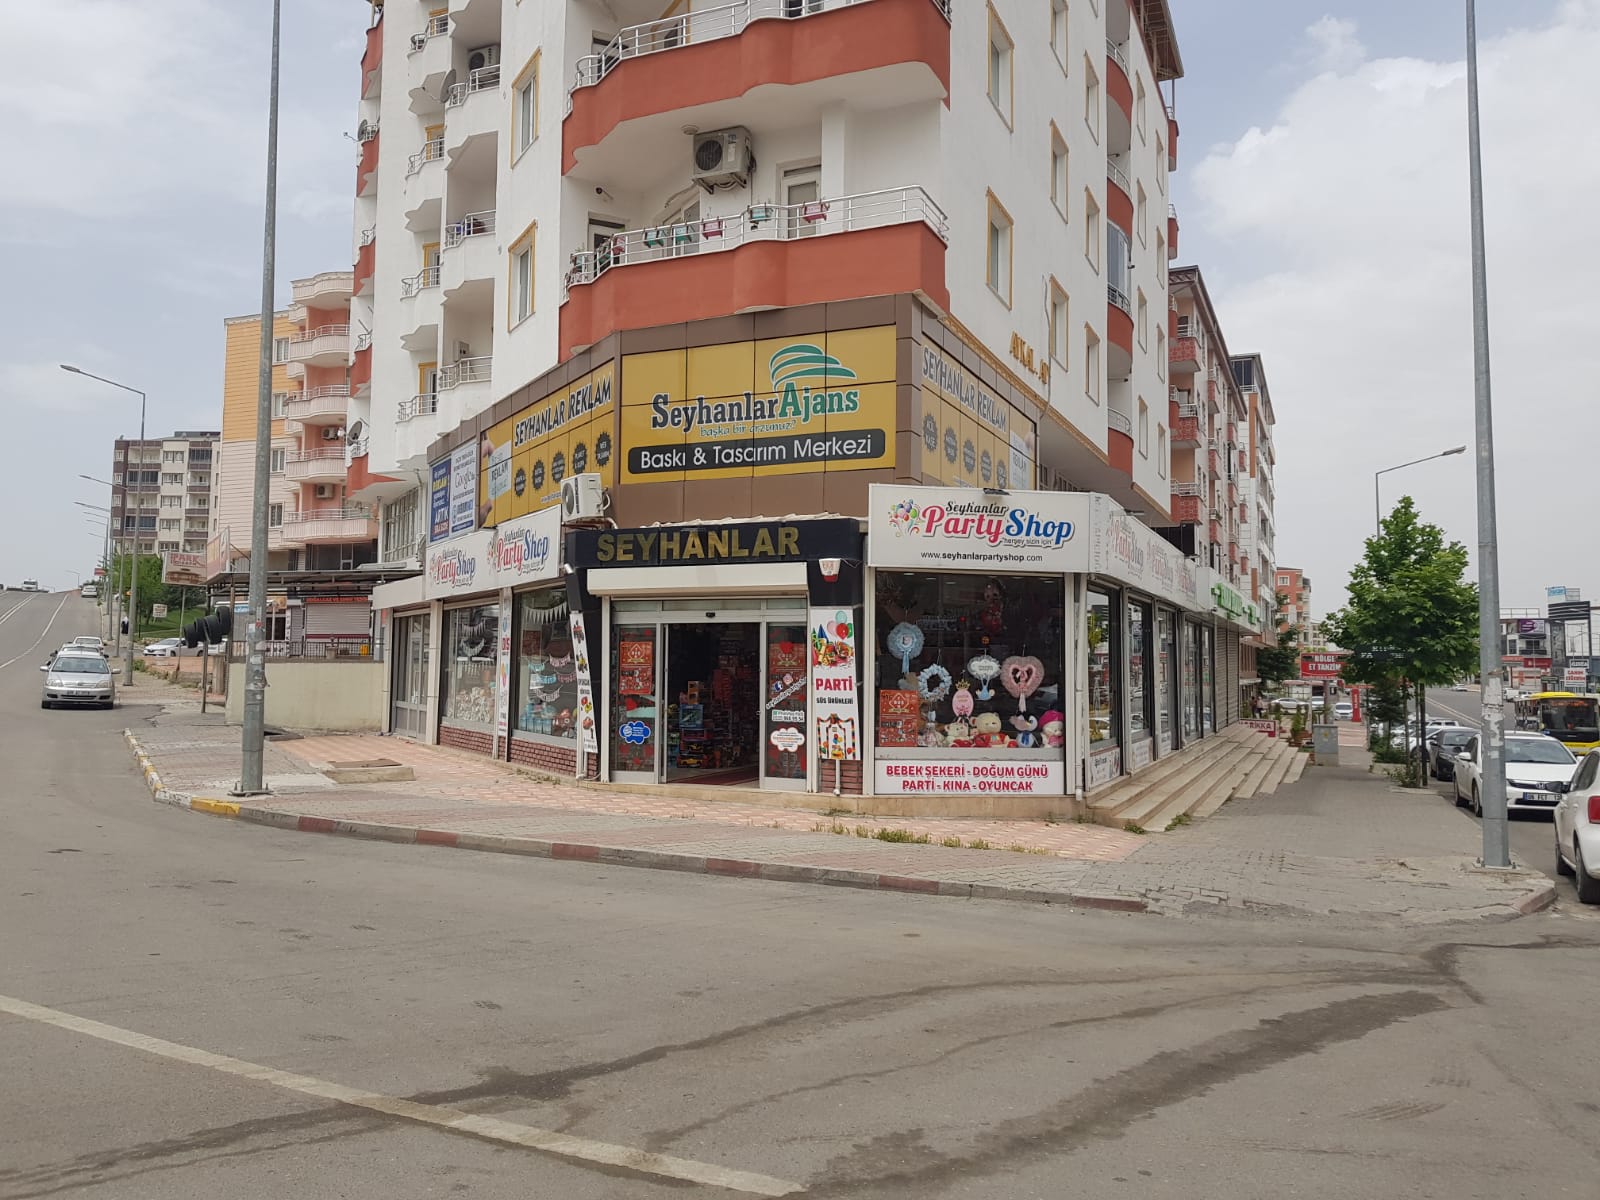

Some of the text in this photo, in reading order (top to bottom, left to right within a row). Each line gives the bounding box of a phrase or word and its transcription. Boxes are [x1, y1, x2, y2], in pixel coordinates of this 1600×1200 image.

[923, 346, 1006, 432] SEYHANLAR REKLAM
[515, 376, 611, 447] SEYHANLAR REKLAM
[700, 425, 729, 438] başka
[732, 422, 746, 434] bir
[640, 434, 872, 468] Baskı & Tasarım Merkezi
[945, 501, 1008, 515] Seyhanlar
[921, 505, 1004, 544] Party
[1004, 508, 1072, 546] Shop
[496, 529, 549, 575] Party Shop
[597, 526, 801, 562] SEYHANLAR
[920, 551, 1043, 562] www.seyhanlarpartyshop.com
[1308, 663, 1316, 671] ET
[815, 676, 853, 691] PARTİ
[886, 765, 923, 777] BEBEK
[925, 764, 965, 780] ŞEKERİ
[973, 764, 1014, 777] DOĞUM
[1016, 764, 1048, 778] GÜNÜ
[902, 779, 935, 791] PARTİ
[943, 780, 970, 791] KINA
[979, 781, 1033, 792] OYUNCAK
